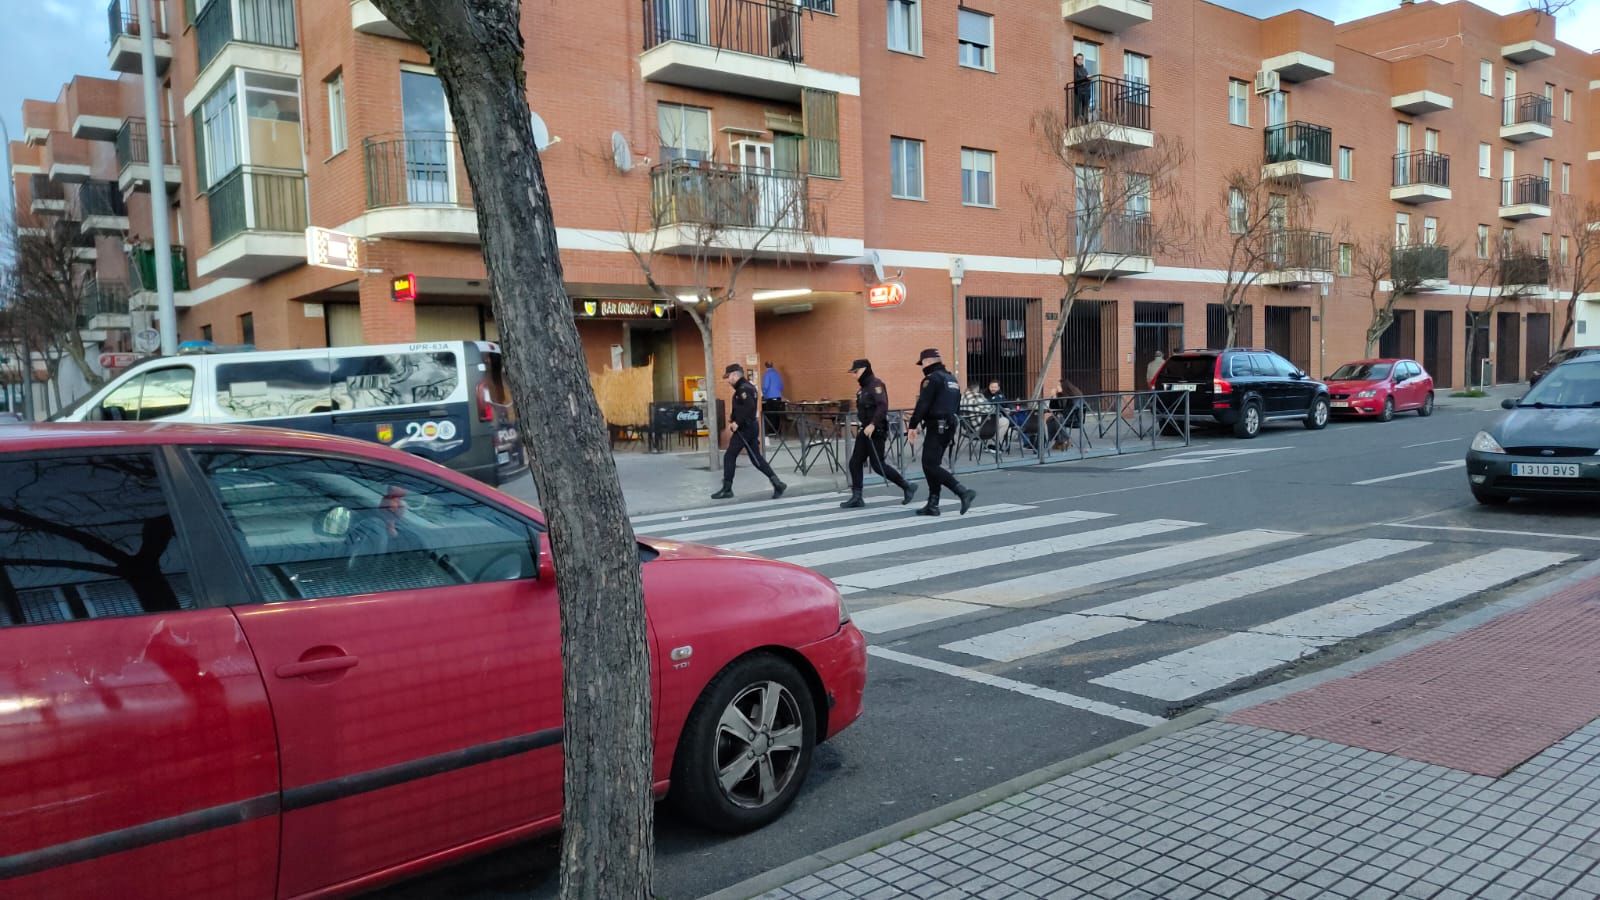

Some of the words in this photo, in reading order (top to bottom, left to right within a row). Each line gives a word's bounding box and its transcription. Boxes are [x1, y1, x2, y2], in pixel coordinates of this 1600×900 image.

[601, 301, 617, 316] BAR
[1521, 465, 1549, 476] 1310
[1552, 465, 1576, 476] BVS
